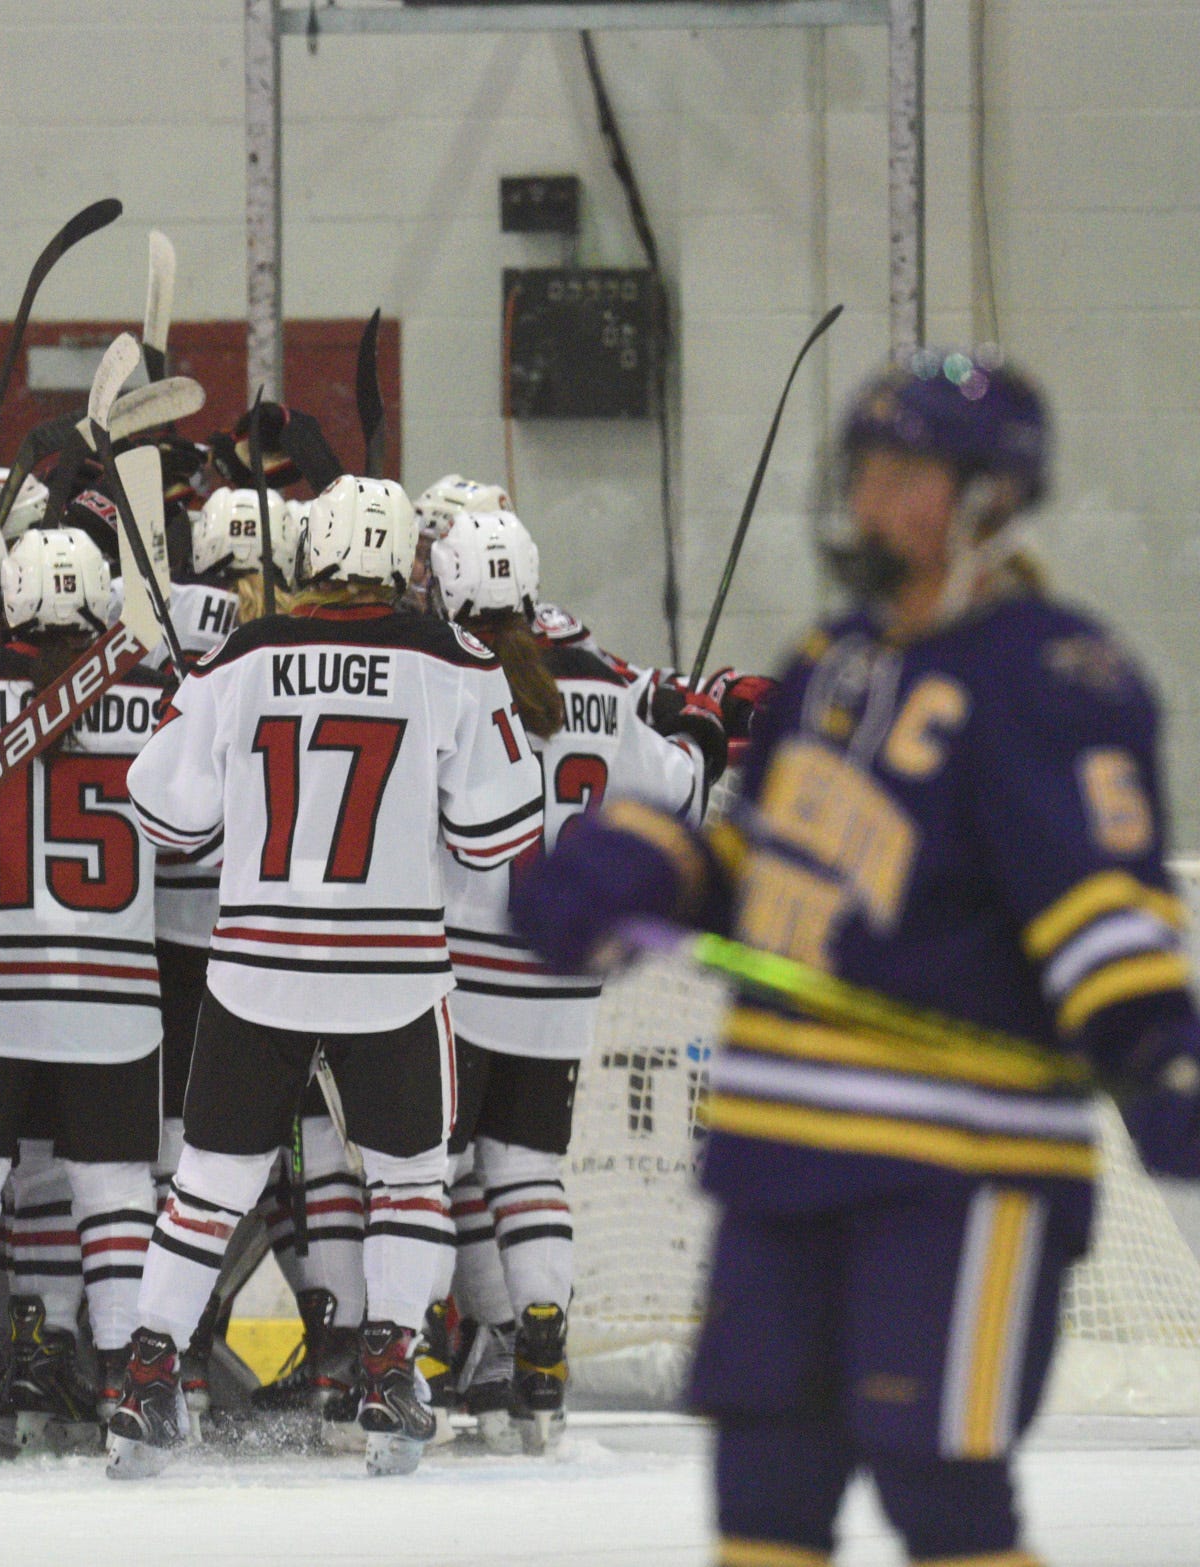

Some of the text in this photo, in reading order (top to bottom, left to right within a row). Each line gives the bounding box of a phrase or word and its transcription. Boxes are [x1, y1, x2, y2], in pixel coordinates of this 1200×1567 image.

[229, 519, 257, 538] 82
[363, 526, 388, 549] 17
[487, 558, 512, 579] 12
[272, 653, 391, 698] KLUGE
[251, 713, 408, 884] 17
